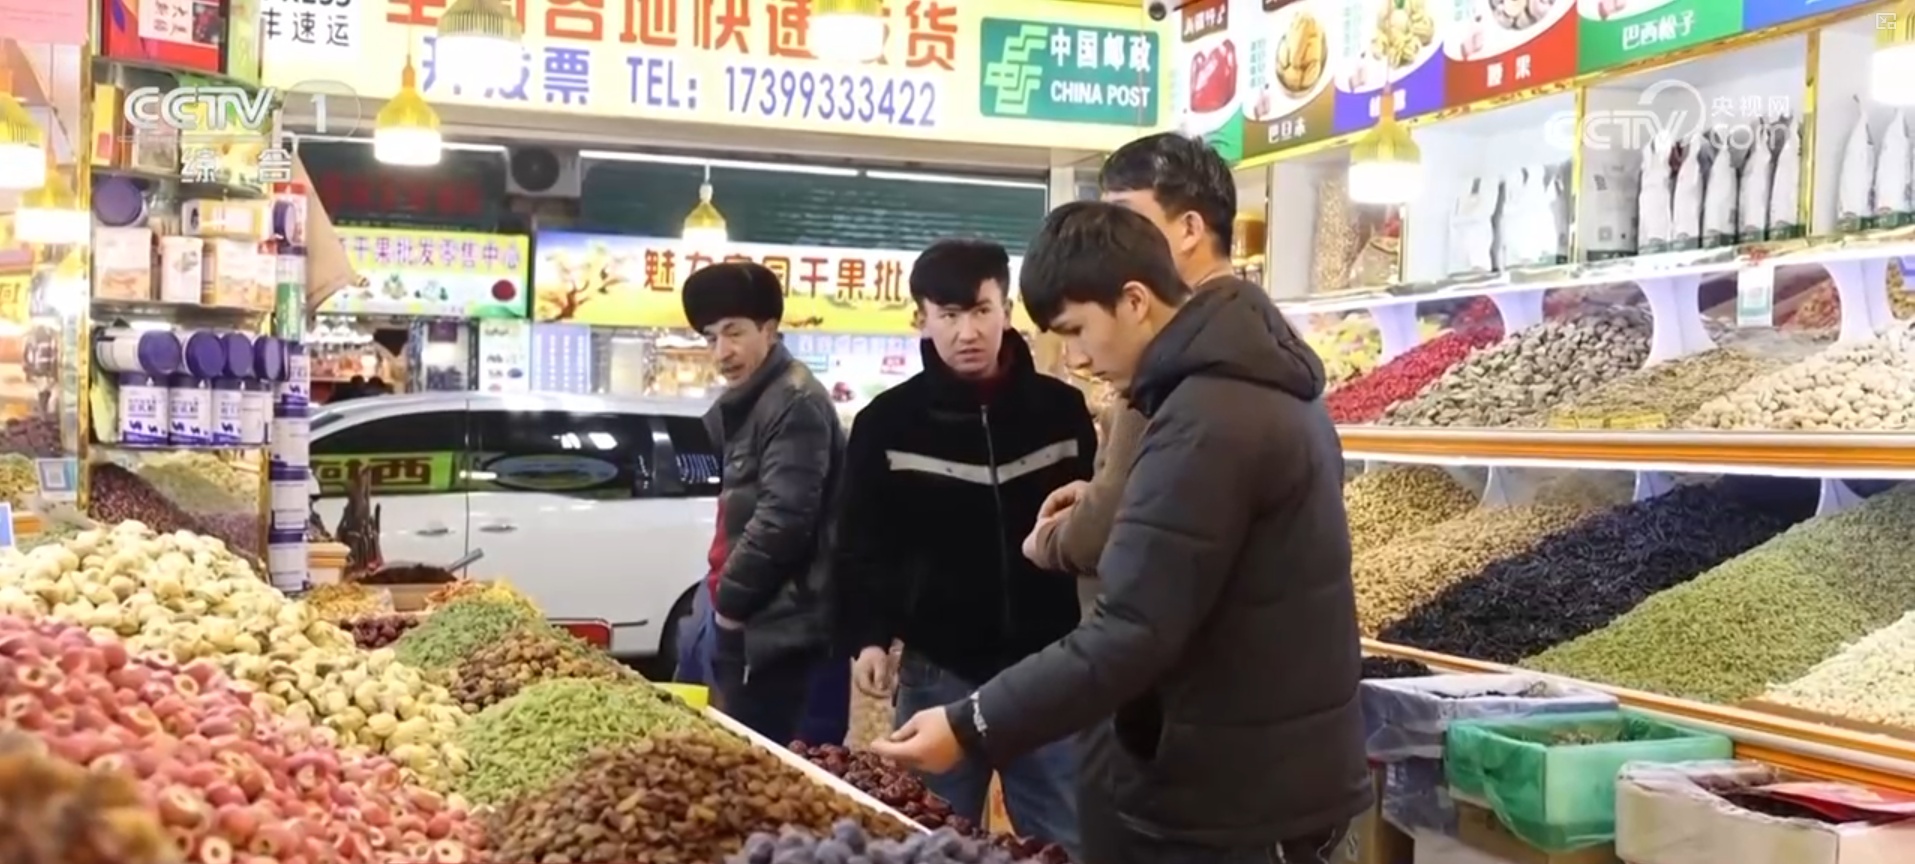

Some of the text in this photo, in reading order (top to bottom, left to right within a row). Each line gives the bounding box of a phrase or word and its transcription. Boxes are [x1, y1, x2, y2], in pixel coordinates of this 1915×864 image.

[1050, 27, 1152, 72] 中国邮政
[725, 66, 937, 127] 17399333422
[1050, 80, 1151, 107] CHINA POST
